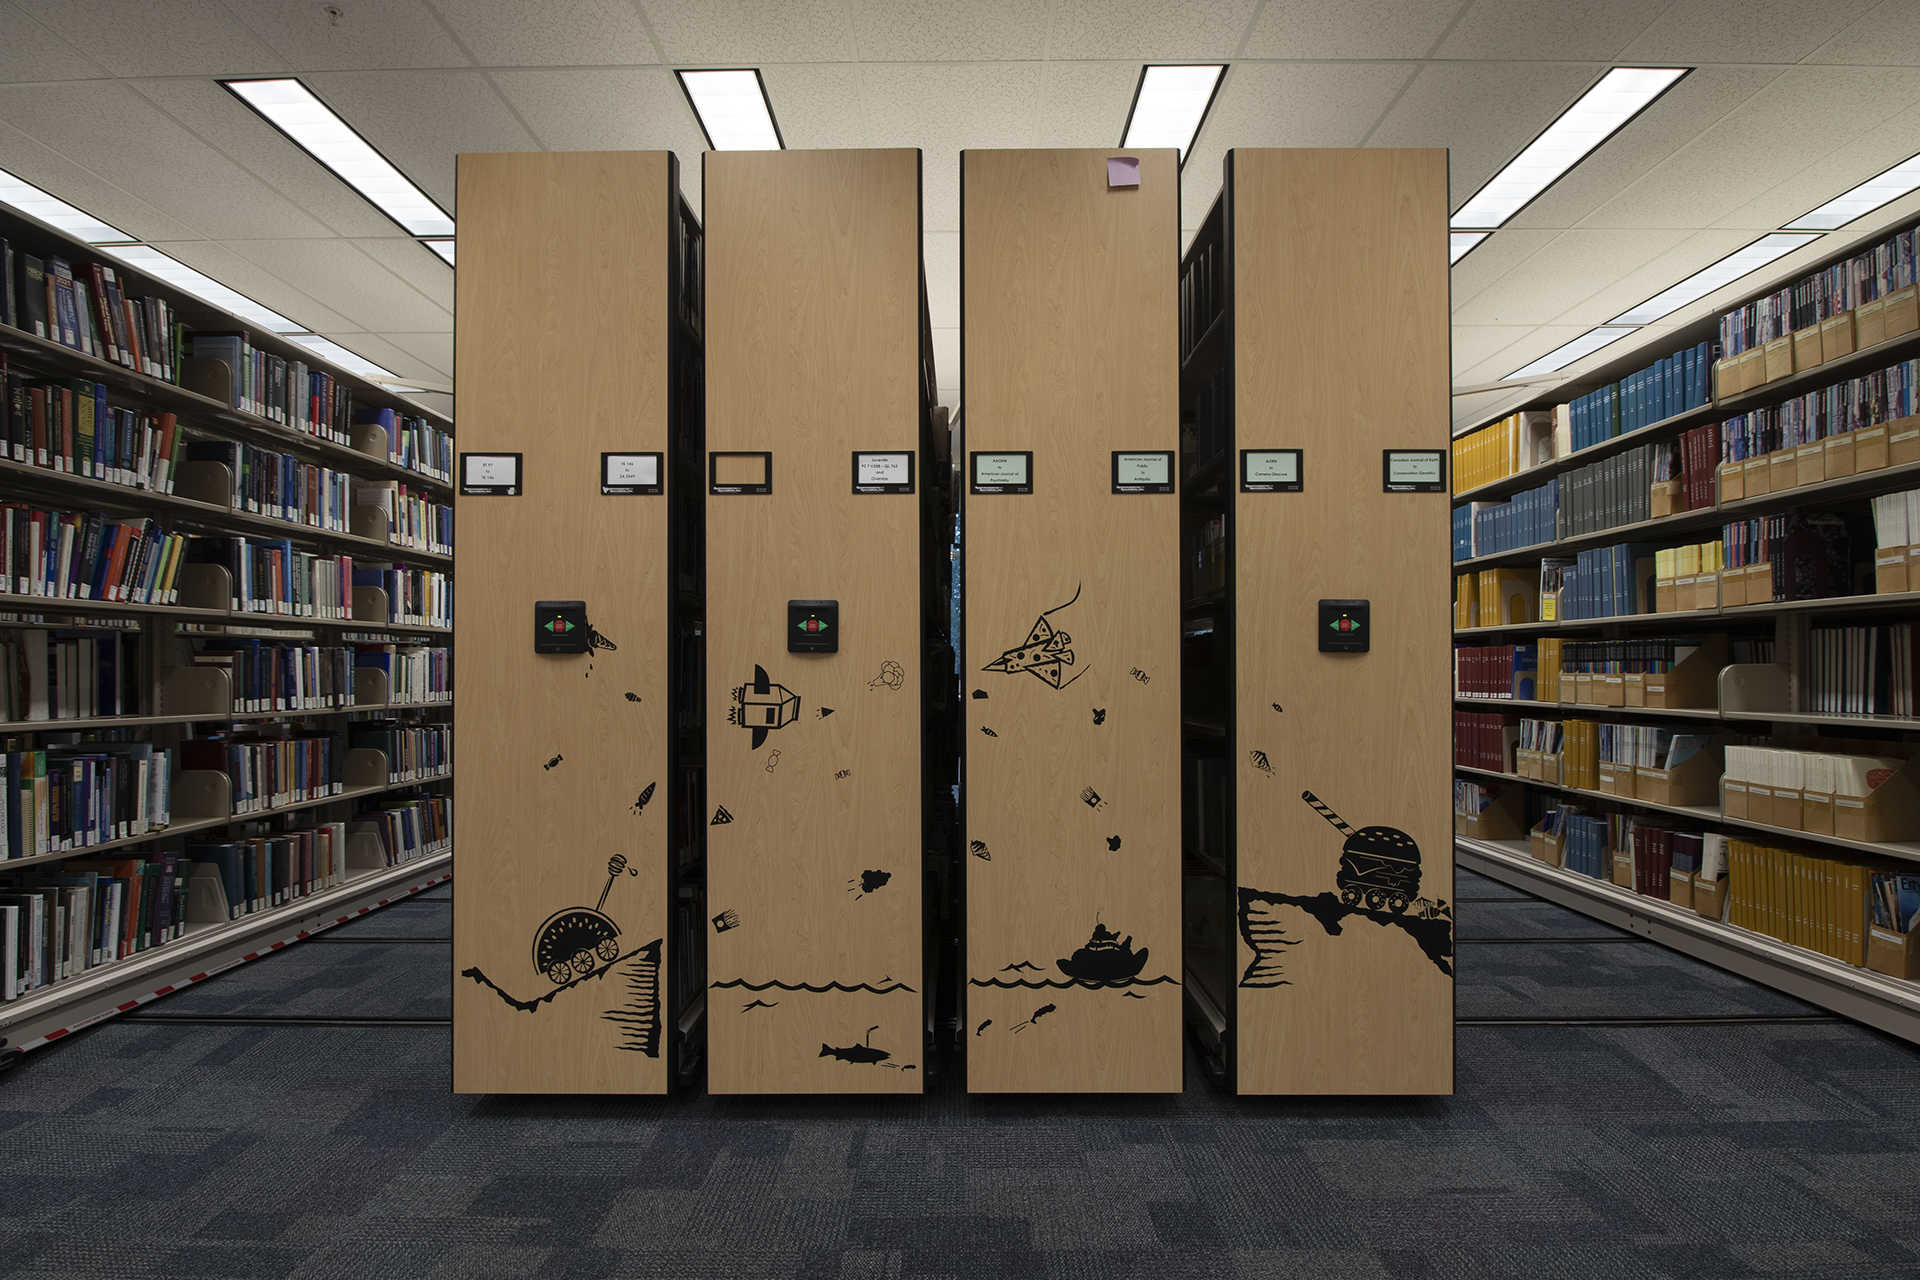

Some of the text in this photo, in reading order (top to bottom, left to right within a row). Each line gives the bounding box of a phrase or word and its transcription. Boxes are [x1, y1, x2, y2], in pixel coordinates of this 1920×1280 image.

[57, 276, 71, 287] 2021
[65, 290, 75, 323] CURRENT
[80, 404, 88, 431] Nursing
